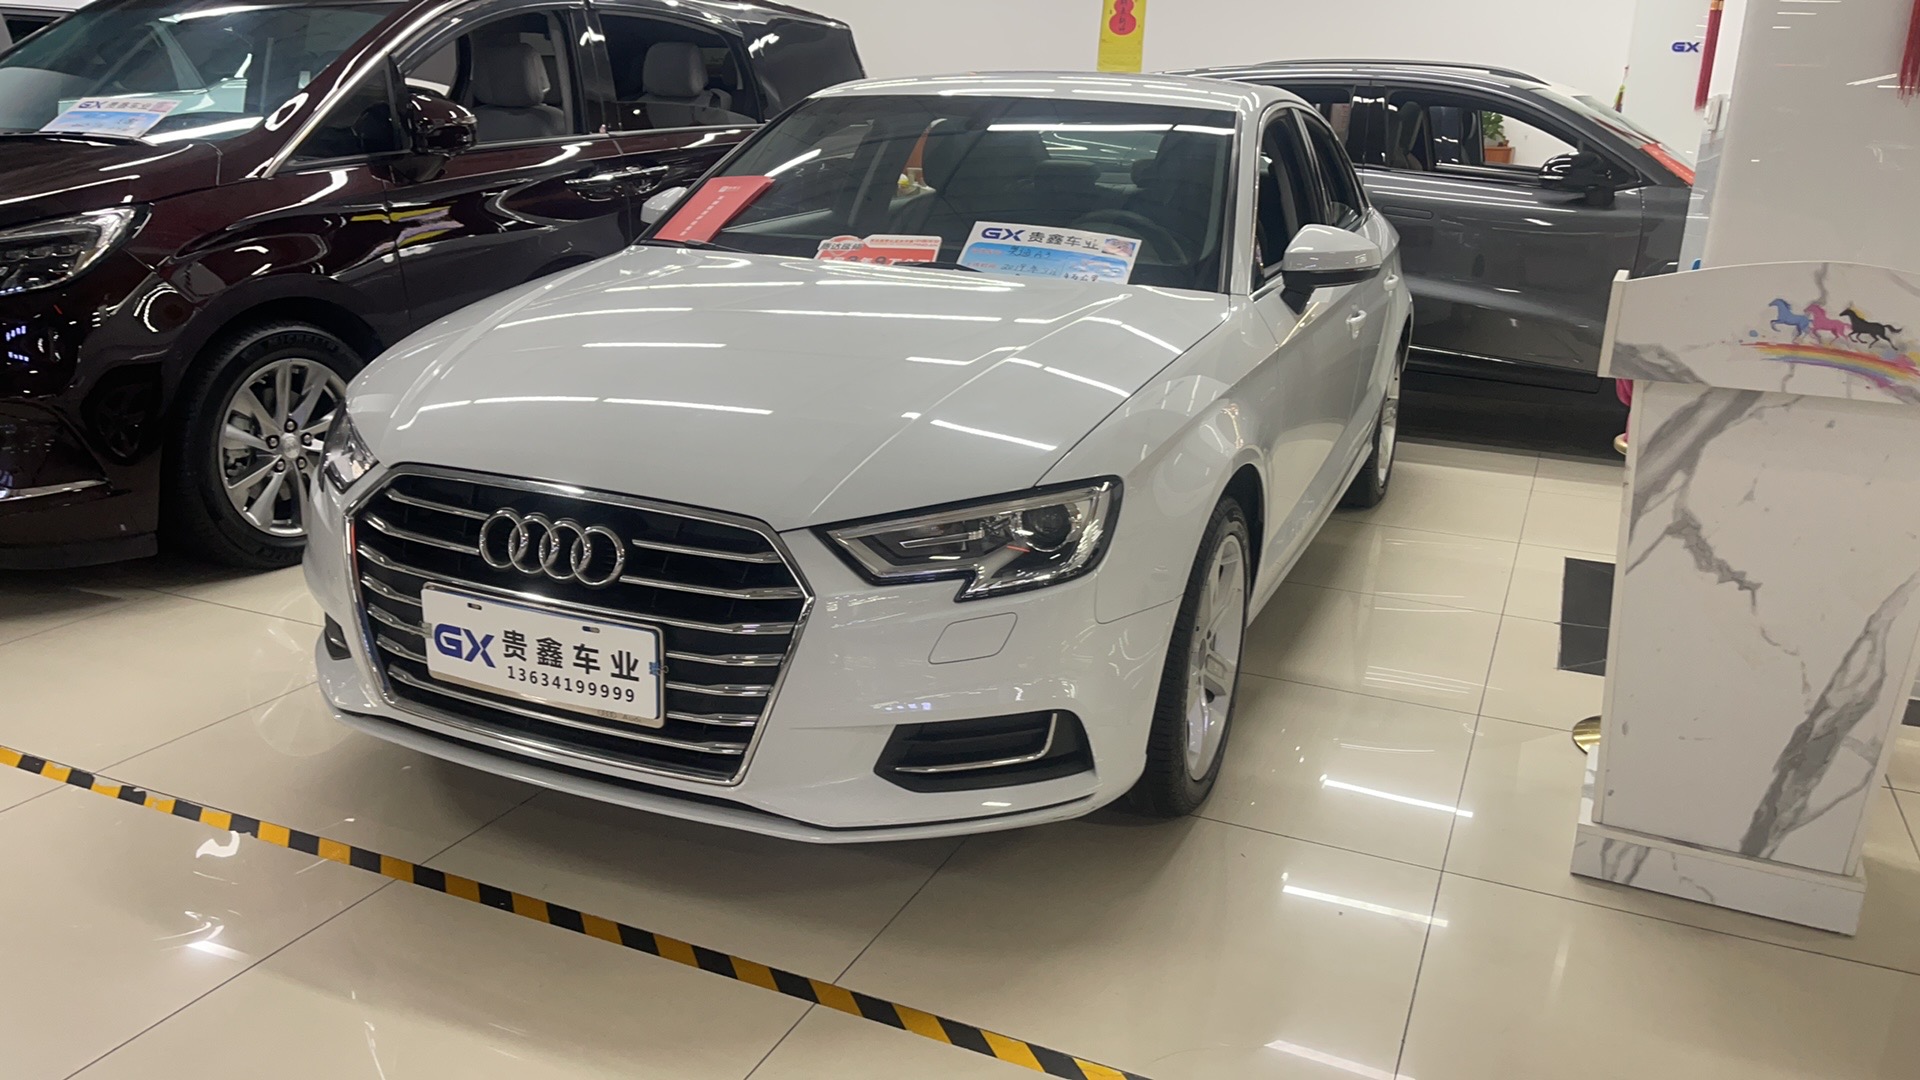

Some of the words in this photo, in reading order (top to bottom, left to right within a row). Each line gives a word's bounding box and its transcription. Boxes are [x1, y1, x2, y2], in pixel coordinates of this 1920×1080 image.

[1671, 41, 1700, 53] GX
[78, 101, 108, 109] GX
[981, 227, 1026, 242] GX
[1027, 231, 1099, 251] 贵鑫车业
[433, 622, 496, 669] GX
[501, 629, 640, 682] 贵鑫车业
[506, 665, 635, 703] 13634199999
